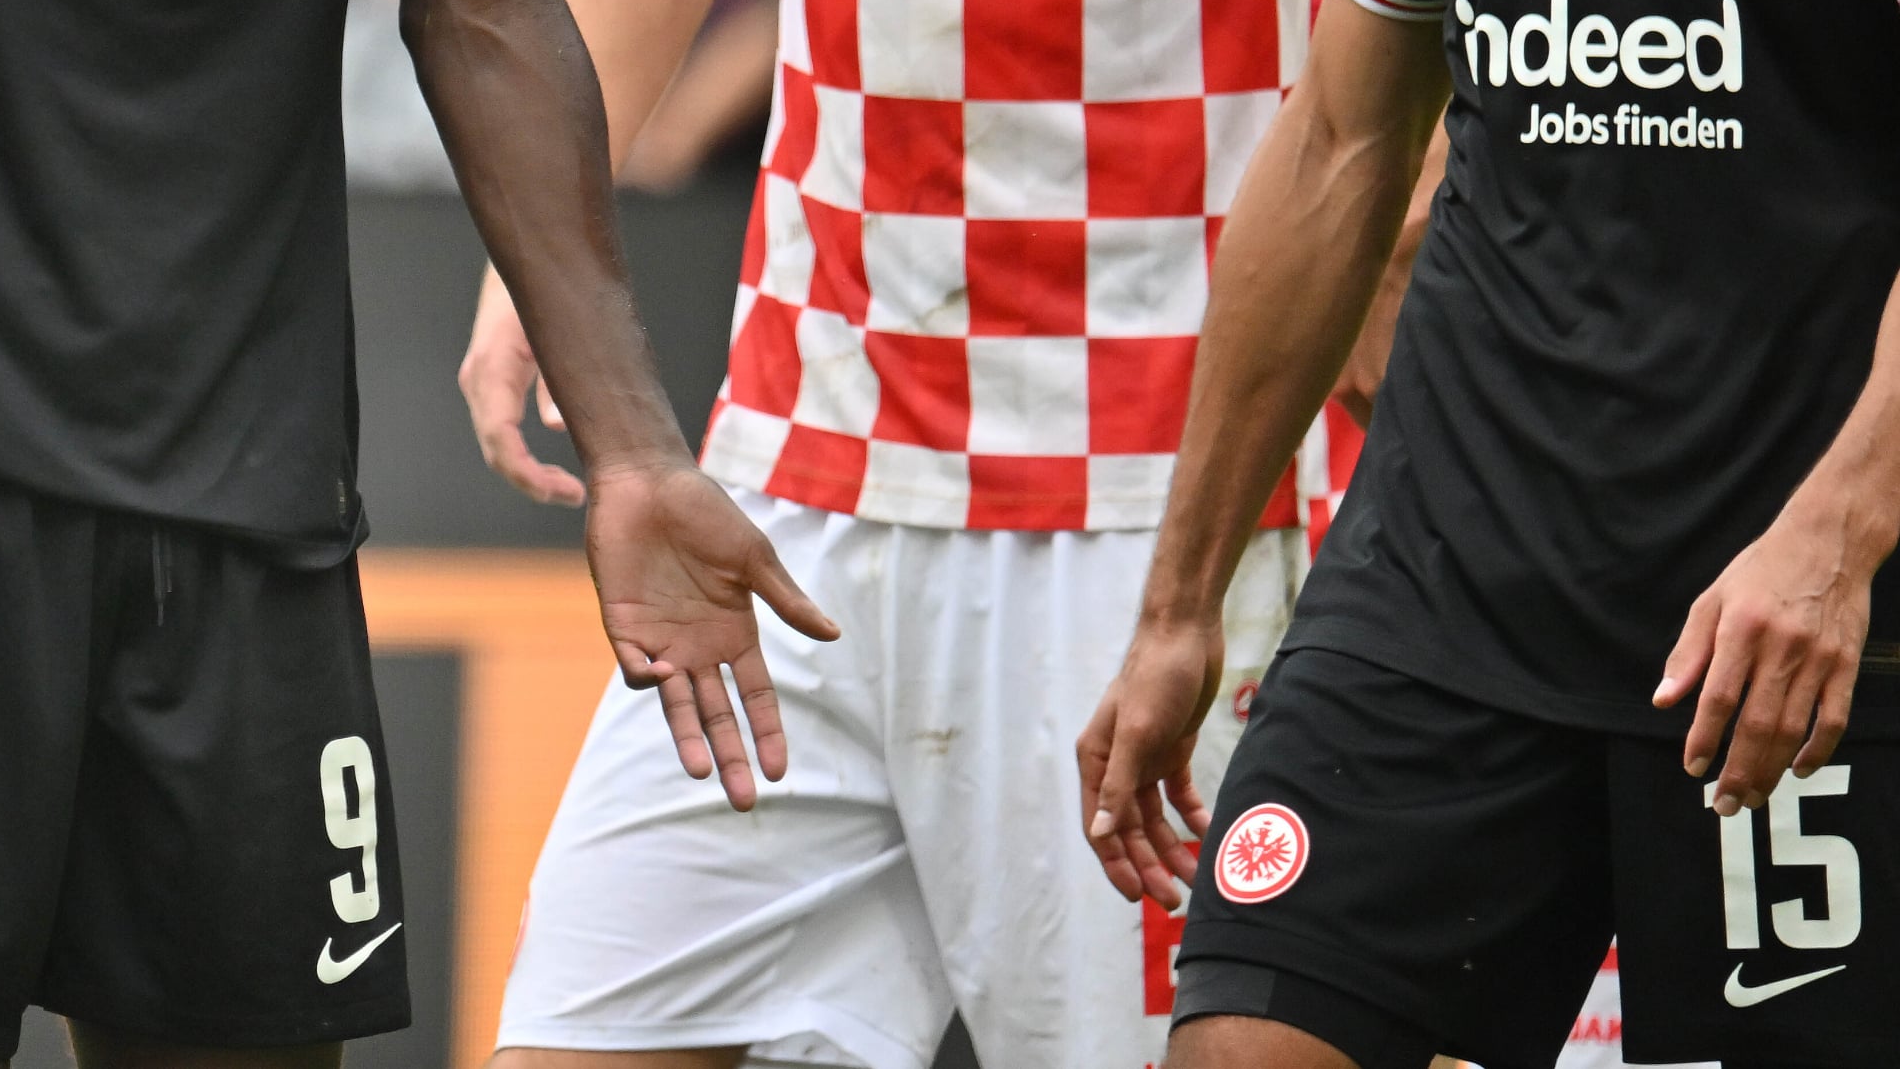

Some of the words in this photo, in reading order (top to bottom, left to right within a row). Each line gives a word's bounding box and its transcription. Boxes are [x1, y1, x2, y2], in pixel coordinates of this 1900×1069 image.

[1520, 102, 1610, 144] Jobs
[1613, 103, 1743, 149] finden
[320, 736, 380, 923] 9
[1704, 765, 1862, 949] 15
